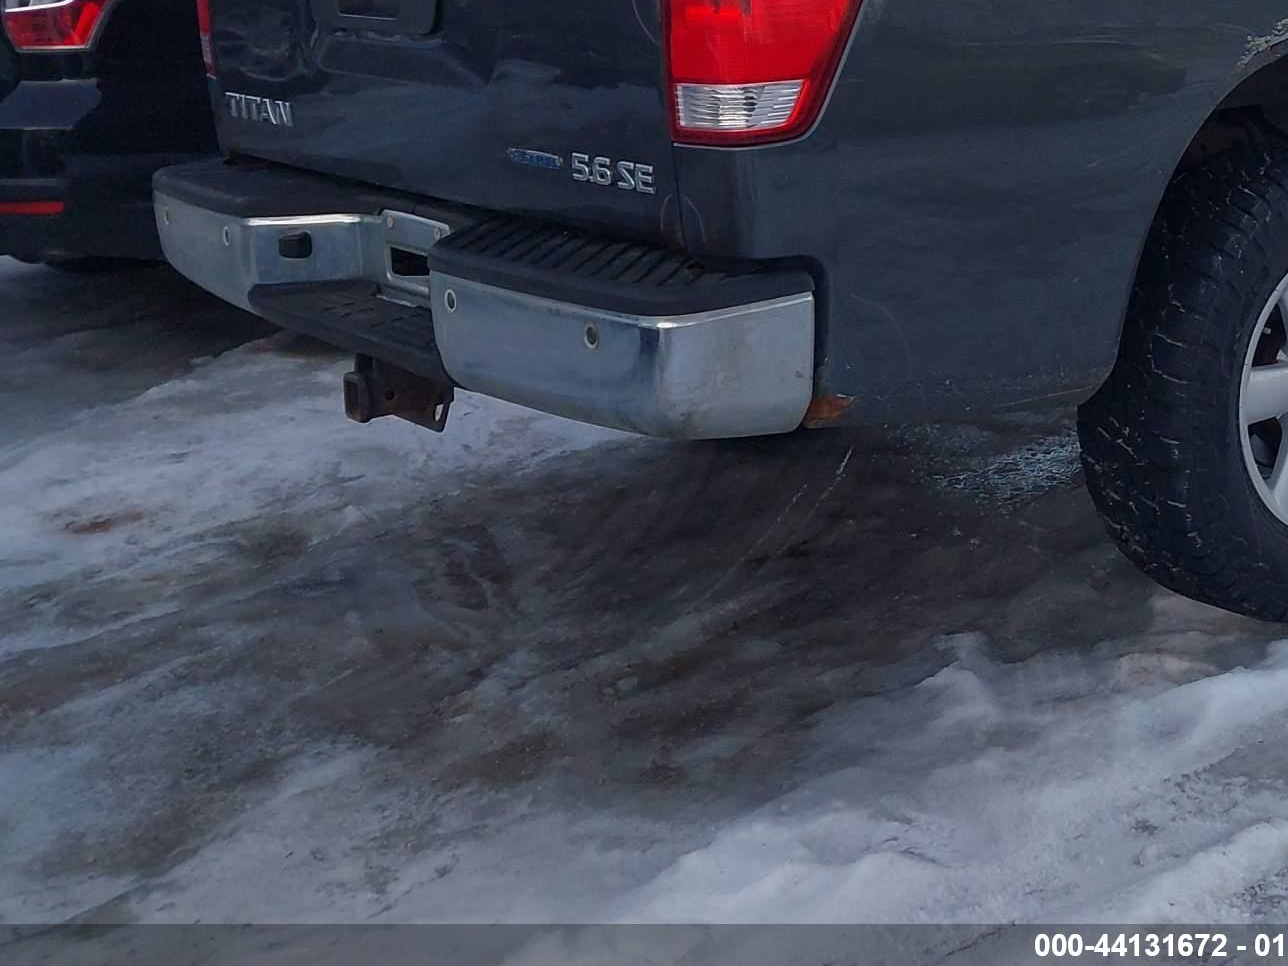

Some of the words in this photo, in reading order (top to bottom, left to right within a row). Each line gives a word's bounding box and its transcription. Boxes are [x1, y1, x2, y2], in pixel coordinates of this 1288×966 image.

[225, 91, 293, 127] TITAN
[571, 152, 611, 185] 5.6
[617, 161, 656, 194] SE
